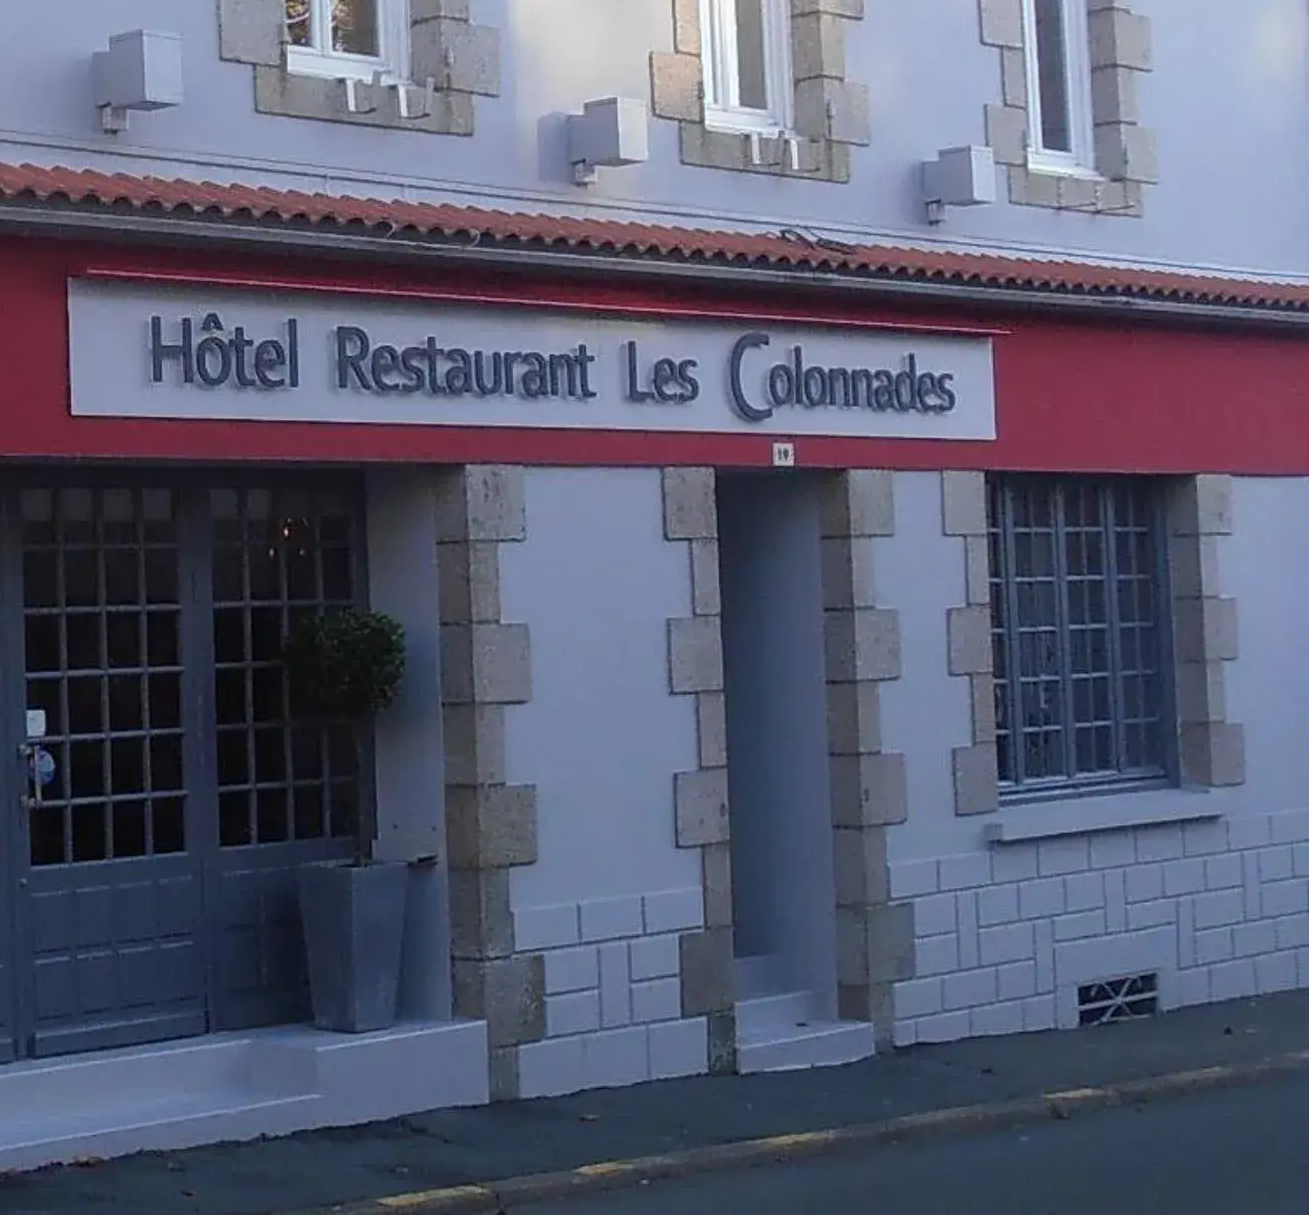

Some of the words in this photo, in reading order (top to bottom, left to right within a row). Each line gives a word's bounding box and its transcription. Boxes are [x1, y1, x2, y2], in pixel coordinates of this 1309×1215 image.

[150, 312, 300, 389] Hôtel
[335, 325, 597, 400] Restaurant
[626, 339, 701, 404] Les
[729, 331, 957, 422] Colonnades
